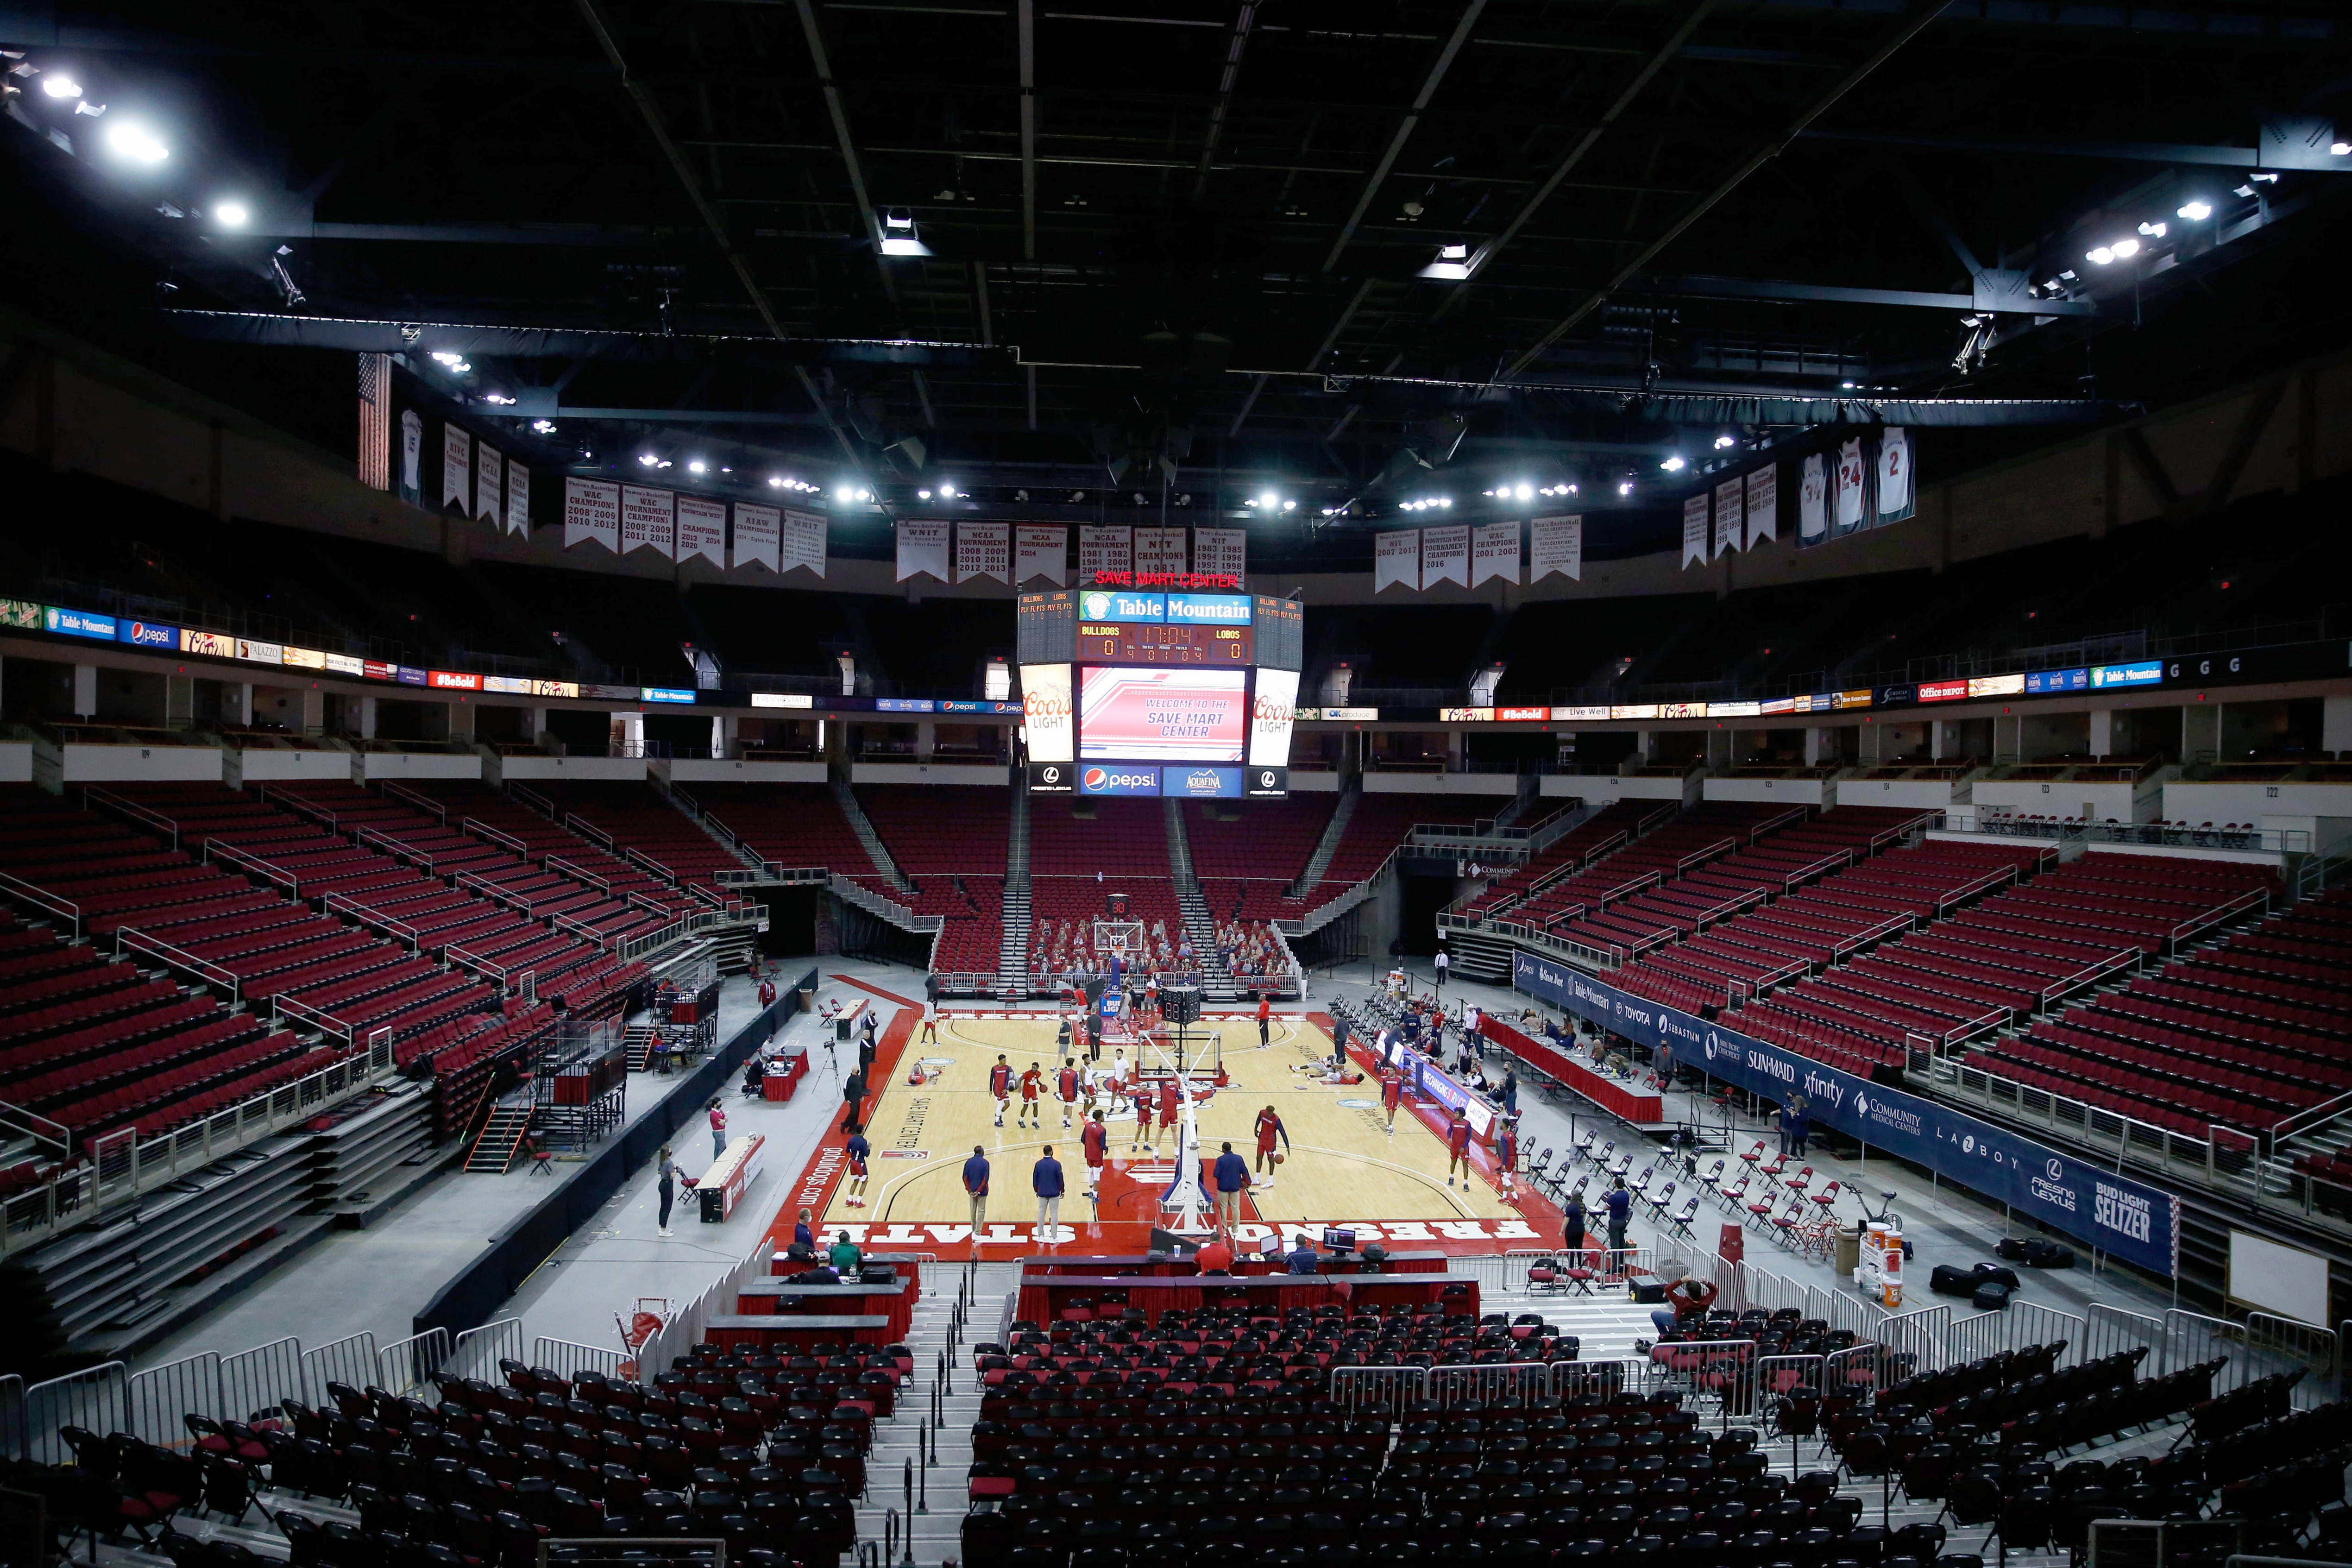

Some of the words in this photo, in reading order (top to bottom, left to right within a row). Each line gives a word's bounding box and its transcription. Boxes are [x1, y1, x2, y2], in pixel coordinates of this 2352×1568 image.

[1890, 451, 1898, 476] 2
[1841, 461, 1860, 491] 24
[570, 497, 615, 509] CHAMPIONS
[595, 510, 616, 519] 2009
[625, 504, 671, 516] TOURNAMENT
[682, 508, 707, 517] MOUNTAIN
[568, 516, 590, 525] 2010
[595, 520, 616, 529] 2012
[628, 513, 668, 523] CHAMPIONS
[794, 520, 818, 529] WNIT
[650, 525, 670, 533] 2009
[683, 524, 719, 535] CHAMPIONS
[625, 531, 646, 540] 2011
[650, 534, 671, 543] 2012
[1477, 539, 1516, 548] CHAMPIONS
[1425, 543, 1466, 551] TOURNAMENT
[1147, 564, 1175, 573] 1983
[1095, 571, 1132, 585] SAVE
[1136, 572, 1176, 586] MART
[1179, 573, 1238, 587] CENTER
[1117, 599, 1162, 616] Table
[1168, 600, 1250, 618] Mountain
[61, 615, 80, 629] Table
[82, 618, 114, 634] Mountain
[1082, 626, 1119, 636] BULLDOGS
[145, 629, 169, 644] pepsi
[1146, 627, 1192, 644] 17:04
[1216, 630, 1240, 639] LOBOS
[250, 642, 278, 658] PALAZZO
[1104, 640, 1114, 655] 0
[1231, 643, 1240, 659] 0
[1128, 650, 1133, 659] 4
[1148, 650, 1154, 660] 0
[1182, 651, 1188, 661] 0
[1195, 652, 1201, 661] 4
[2170, 664, 2179, 677] G
[2200, 661, 2209, 674] G
[2229, 657, 2239, 672] G
[437, 674, 475, 688] #BeBold
[2106, 670, 2125, 682] Table
[2126, 668, 2161, 680] Mountain
[654, 692, 668, 700] Table
[1920, 686, 1942, 698] Office
[1942, 687, 1965, 696] DEPOT
[955, 703, 976, 711] pepsi
[1022, 691, 1072, 717] Coors
[1146, 699, 1195, 709] WELCOME
[1197, 699, 1209, 709] TO
[1211, 699, 1229, 709] THE
[1253, 695, 1295, 722] Coors
[1148, 712, 1183, 724] SAVE
[1186, 713, 1224, 725] MART
[1342, 711, 1370, 720] produce
[1503, 709, 1541, 720] #BeBold
[1033, 717, 1064, 729] LIGHT
[1259, 721, 1286, 733] LIGHT
[1162, 726, 1209, 737] CENTER
[1109, 773, 1153, 789] pepsi
[1186, 775, 1221, 788] AQUAFINA
[2267, 787, 2278, 797] 122
[1113, 903, 1125, 913] 30
[1524, 964, 1534, 975] pepsi
[1543, 969, 1553, 983] Save
[1553, 973, 1564, 988] Mart
[1575, 981, 1586, 999] Table
[1586, 986, 1609, 1010] Mountain
[1625, 1005, 1650, 1026] TOYOTA
[1668, 1023, 1700, 1043] SEBASTIAN
[1805, 1071, 1844, 1108] xfinity
[1870, 1098, 1921, 1126] COMMUNITY
[1871, 1113, 1894, 1128] MEDICAL
[1895, 1119, 1921, 1136] CENTERS
[895, 1127, 921, 1148] CENTER
[796, 1146, 843, 1205] gobulldogs.com
[2031, 1177, 2075, 1199] FRESNO
[2031, 1186, 2076, 1212] LEXUS
[2096, 1182, 2118, 1199] BUD
[2118, 1188, 2151, 1211] LIGHT
[2094, 1195, 2151, 1243] SELTZER
[817, 1223, 1077, 1244] STATE
